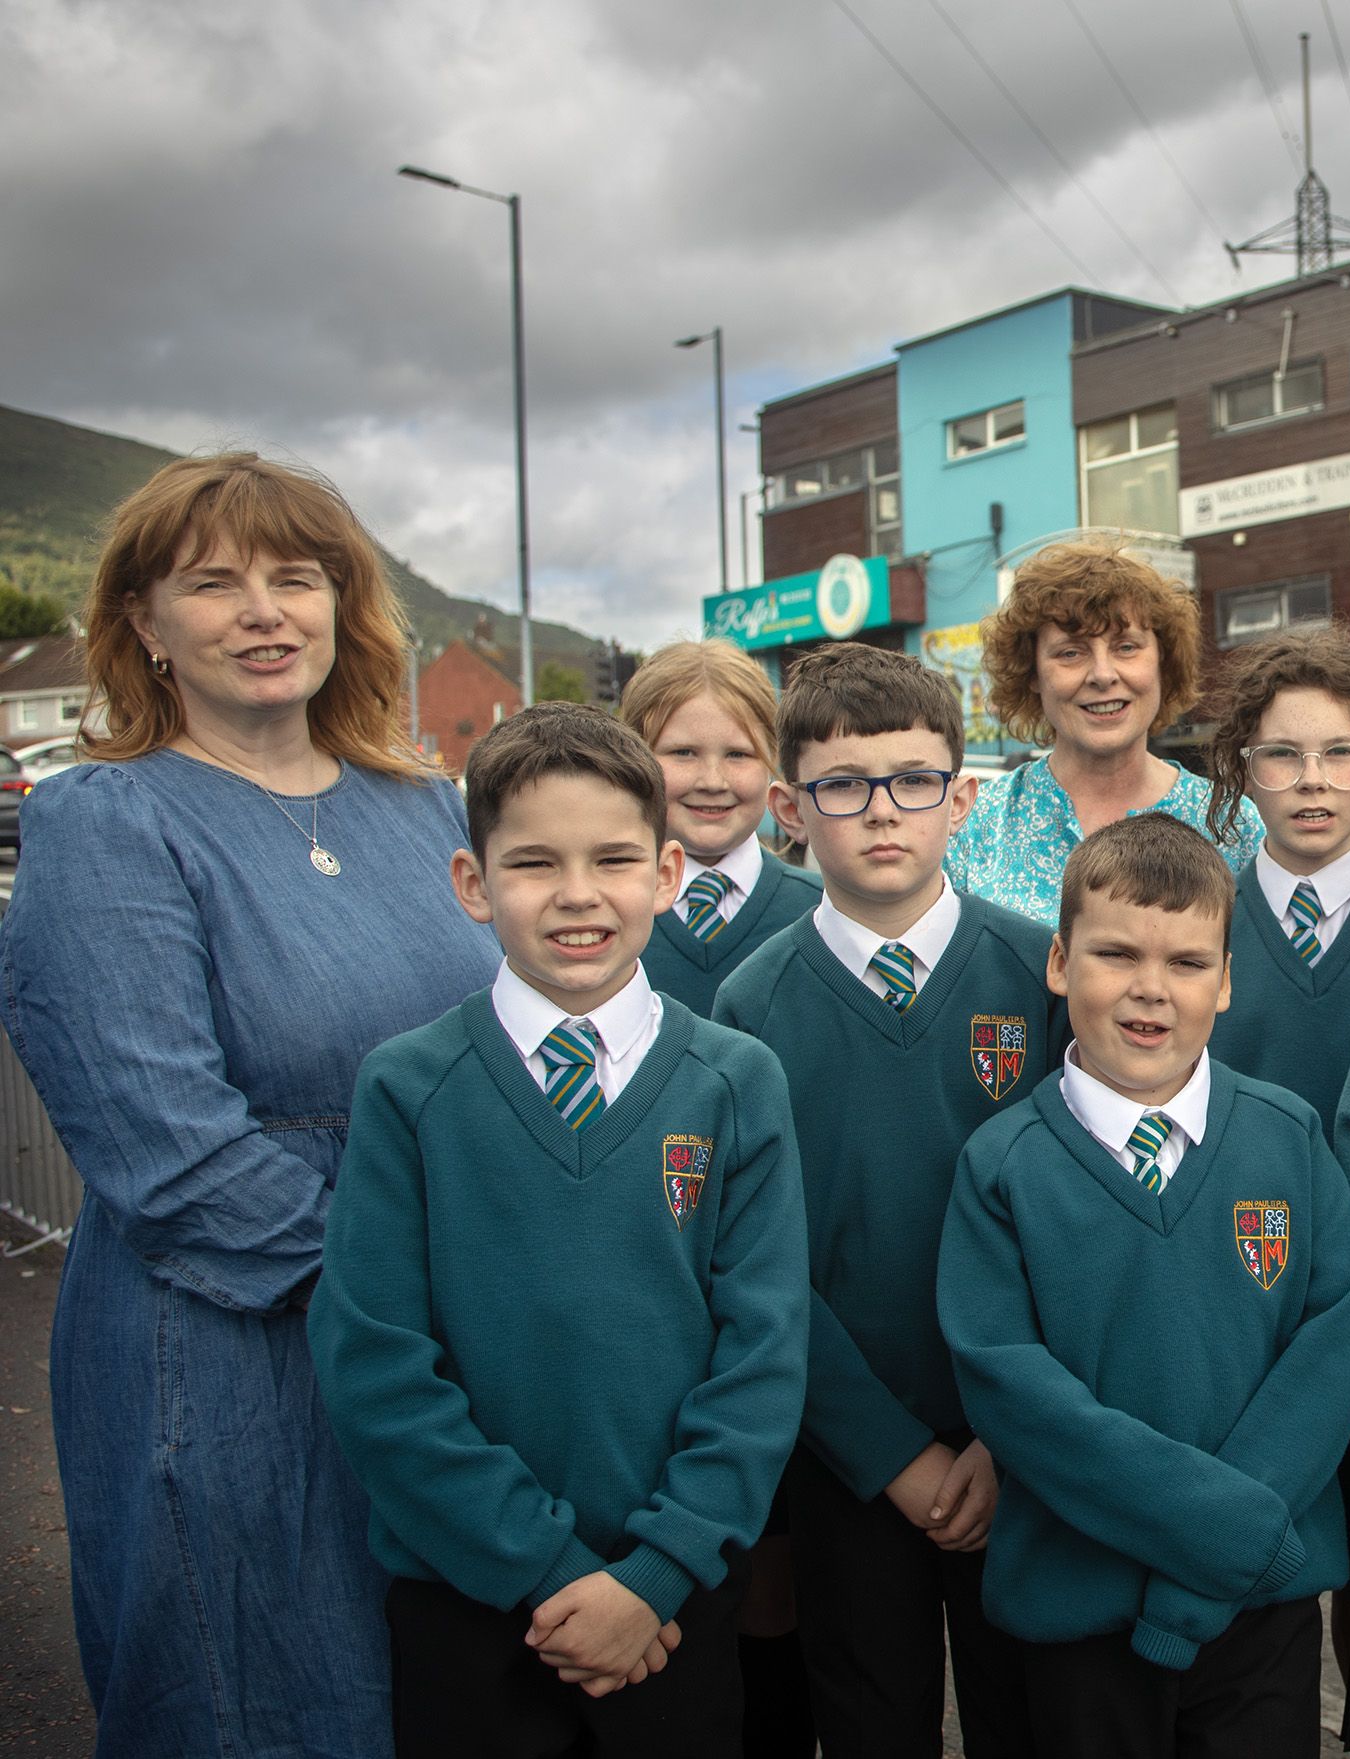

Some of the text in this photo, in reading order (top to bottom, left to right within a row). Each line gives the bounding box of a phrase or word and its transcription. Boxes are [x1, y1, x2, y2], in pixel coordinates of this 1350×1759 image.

[1000, 1052, 1020, 1082] M
[664, 1134, 688, 1142] JOHN
[1234, 1200, 1253, 1208] JOHN
[1254, 1200, 1269, 1208] PAUL
[1265, 1240, 1284, 1271] M
